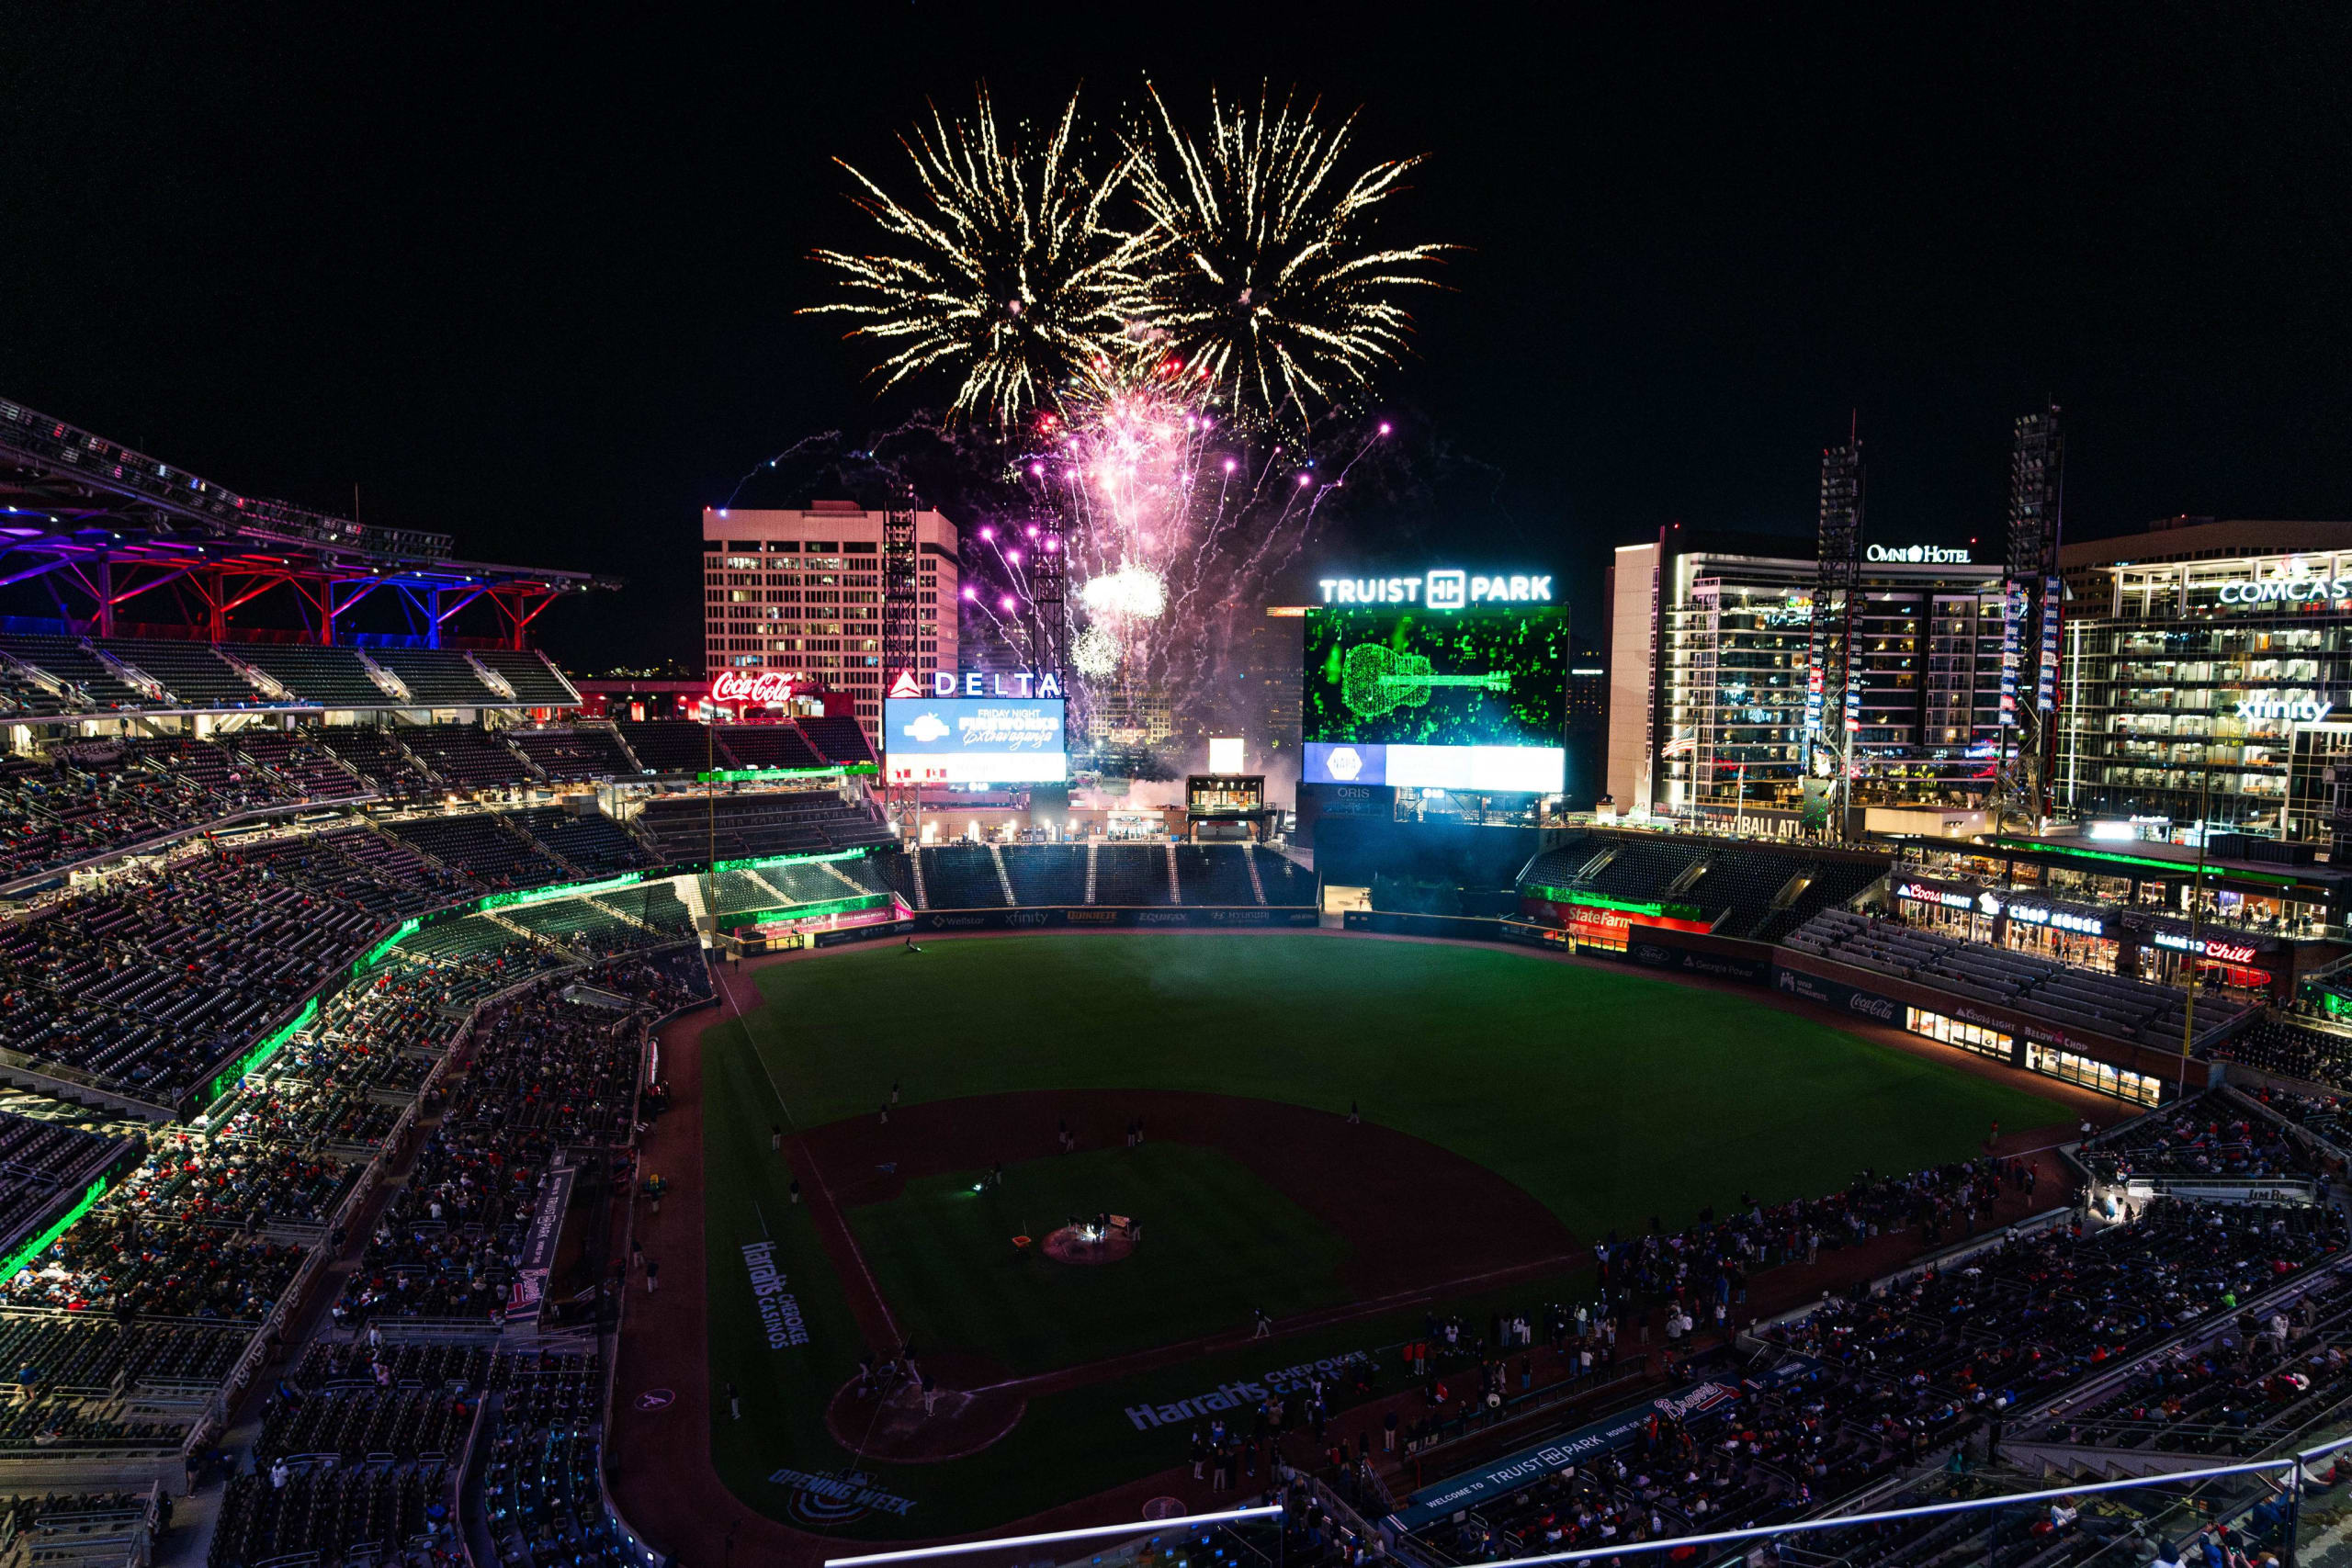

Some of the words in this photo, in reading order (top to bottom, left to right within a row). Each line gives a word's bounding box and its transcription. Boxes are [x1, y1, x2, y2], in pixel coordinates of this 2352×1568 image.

[1867, 544, 1906, 562] OMNI
[1923, 546, 1972, 563] HOTEL
[1318, 578, 1422, 604] TRUIST
[1471, 575, 1553, 602] PARK
[713, 671, 796, 703] Coca-Cola
[935, 671, 1061, 696] DELTA
[978, 708, 1010, 719] FRIDAY
[1012, 708, 1042, 719] NIGHT
[2234, 695, 2332, 724] xfinity
[1338, 787, 1370, 799] ORIS
[1741, 816, 1774, 837] BALL
[1910, 884, 1941, 902] Coors
[946, 917, 984, 927] Wellstar
[1005, 910, 1048, 927] xfinity
[1568, 907, 1600, 925] State
[1600, 911, 1633, 929] Farm
[2009, 905, 2049, 924] CHOP
[2205, 941, 2256, 963] Chill
[1849, 992, 1895, 1020] Coca-Cola
[1966, 1008, 1990, 1024] Coors
[1992, 1019, 2015, 1032] LIGHT
[2024, 1026, 2053, 1044] BELOW
[2064, 1038, 2087, 1052] CHOP
[758, 1297, 790, 1349] CASINOS
[778, 1293, 809, 1346] CHEROKEE
[1426, 1487, 1472, 1508] WELCOME
[1470, 1482, 1484, 1492] TO
[1487, 1457, 1544, 1484] TRUIST
[1562, 1434, 1605, 1456] PARK
[1606, 1425, 1631, 1438] HOME
[1655, 1382, 1718, 1421] Braves
[768, 1469, 857, 1500] OPENING
[853, 1488, 918, 1517] WEEK
